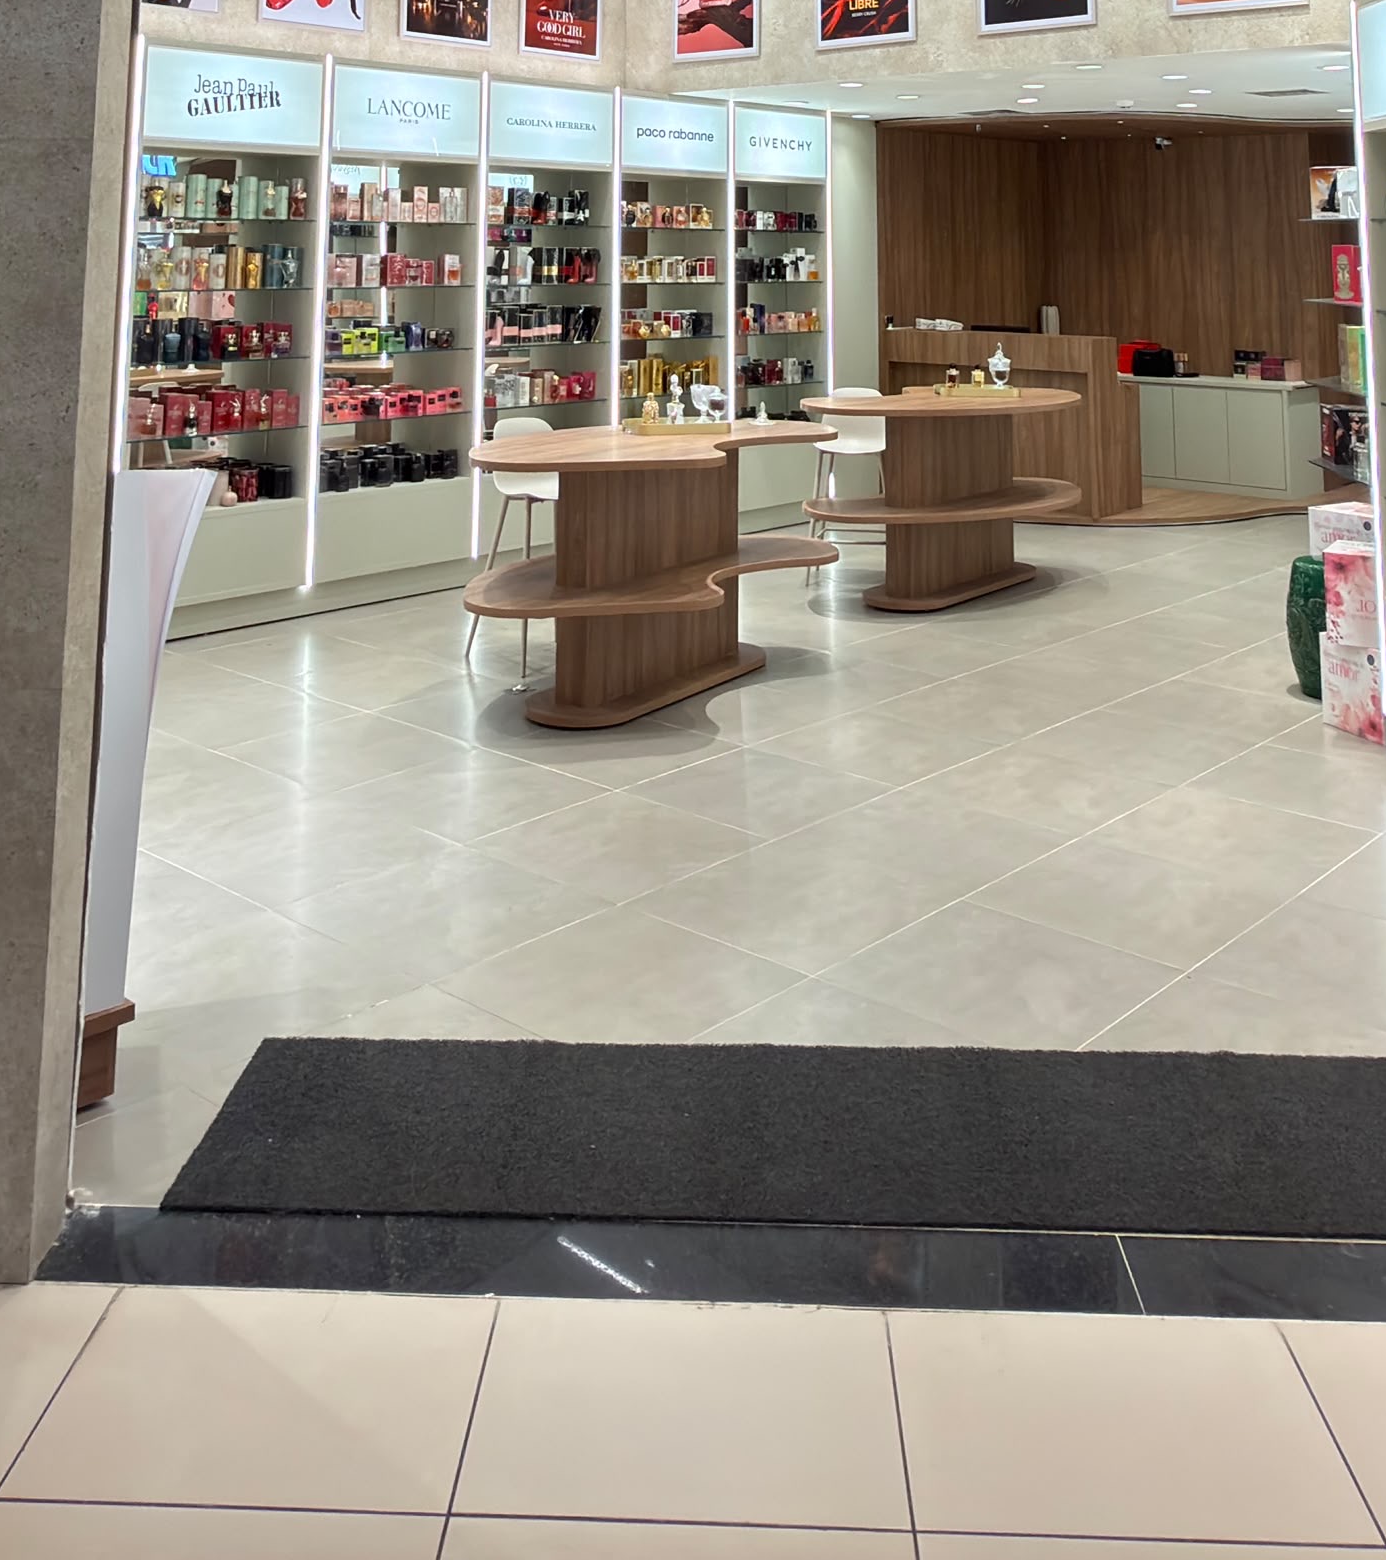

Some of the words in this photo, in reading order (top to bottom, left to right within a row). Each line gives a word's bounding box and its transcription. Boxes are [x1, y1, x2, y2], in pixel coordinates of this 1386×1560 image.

[549, 8, 576, 24] VERY
[536, 20, 562, 35] GOOD
[562, 24, 586, 39] GIRL
[194, 74, 234, 95] Jean
[237, 78, 275, 98] Paul
[187, 90, 282, 117] GAULTIER
[367, 97, 452, 120] LANCOME
[506, 117, 553, 129] CAROLINA
[555, 120, 597, 132] HERRERA
[636, 126, 666, 139] paco
[668, 127, 715, 142] rabanne
[748, 136, 813, 152] GIVENCHY
